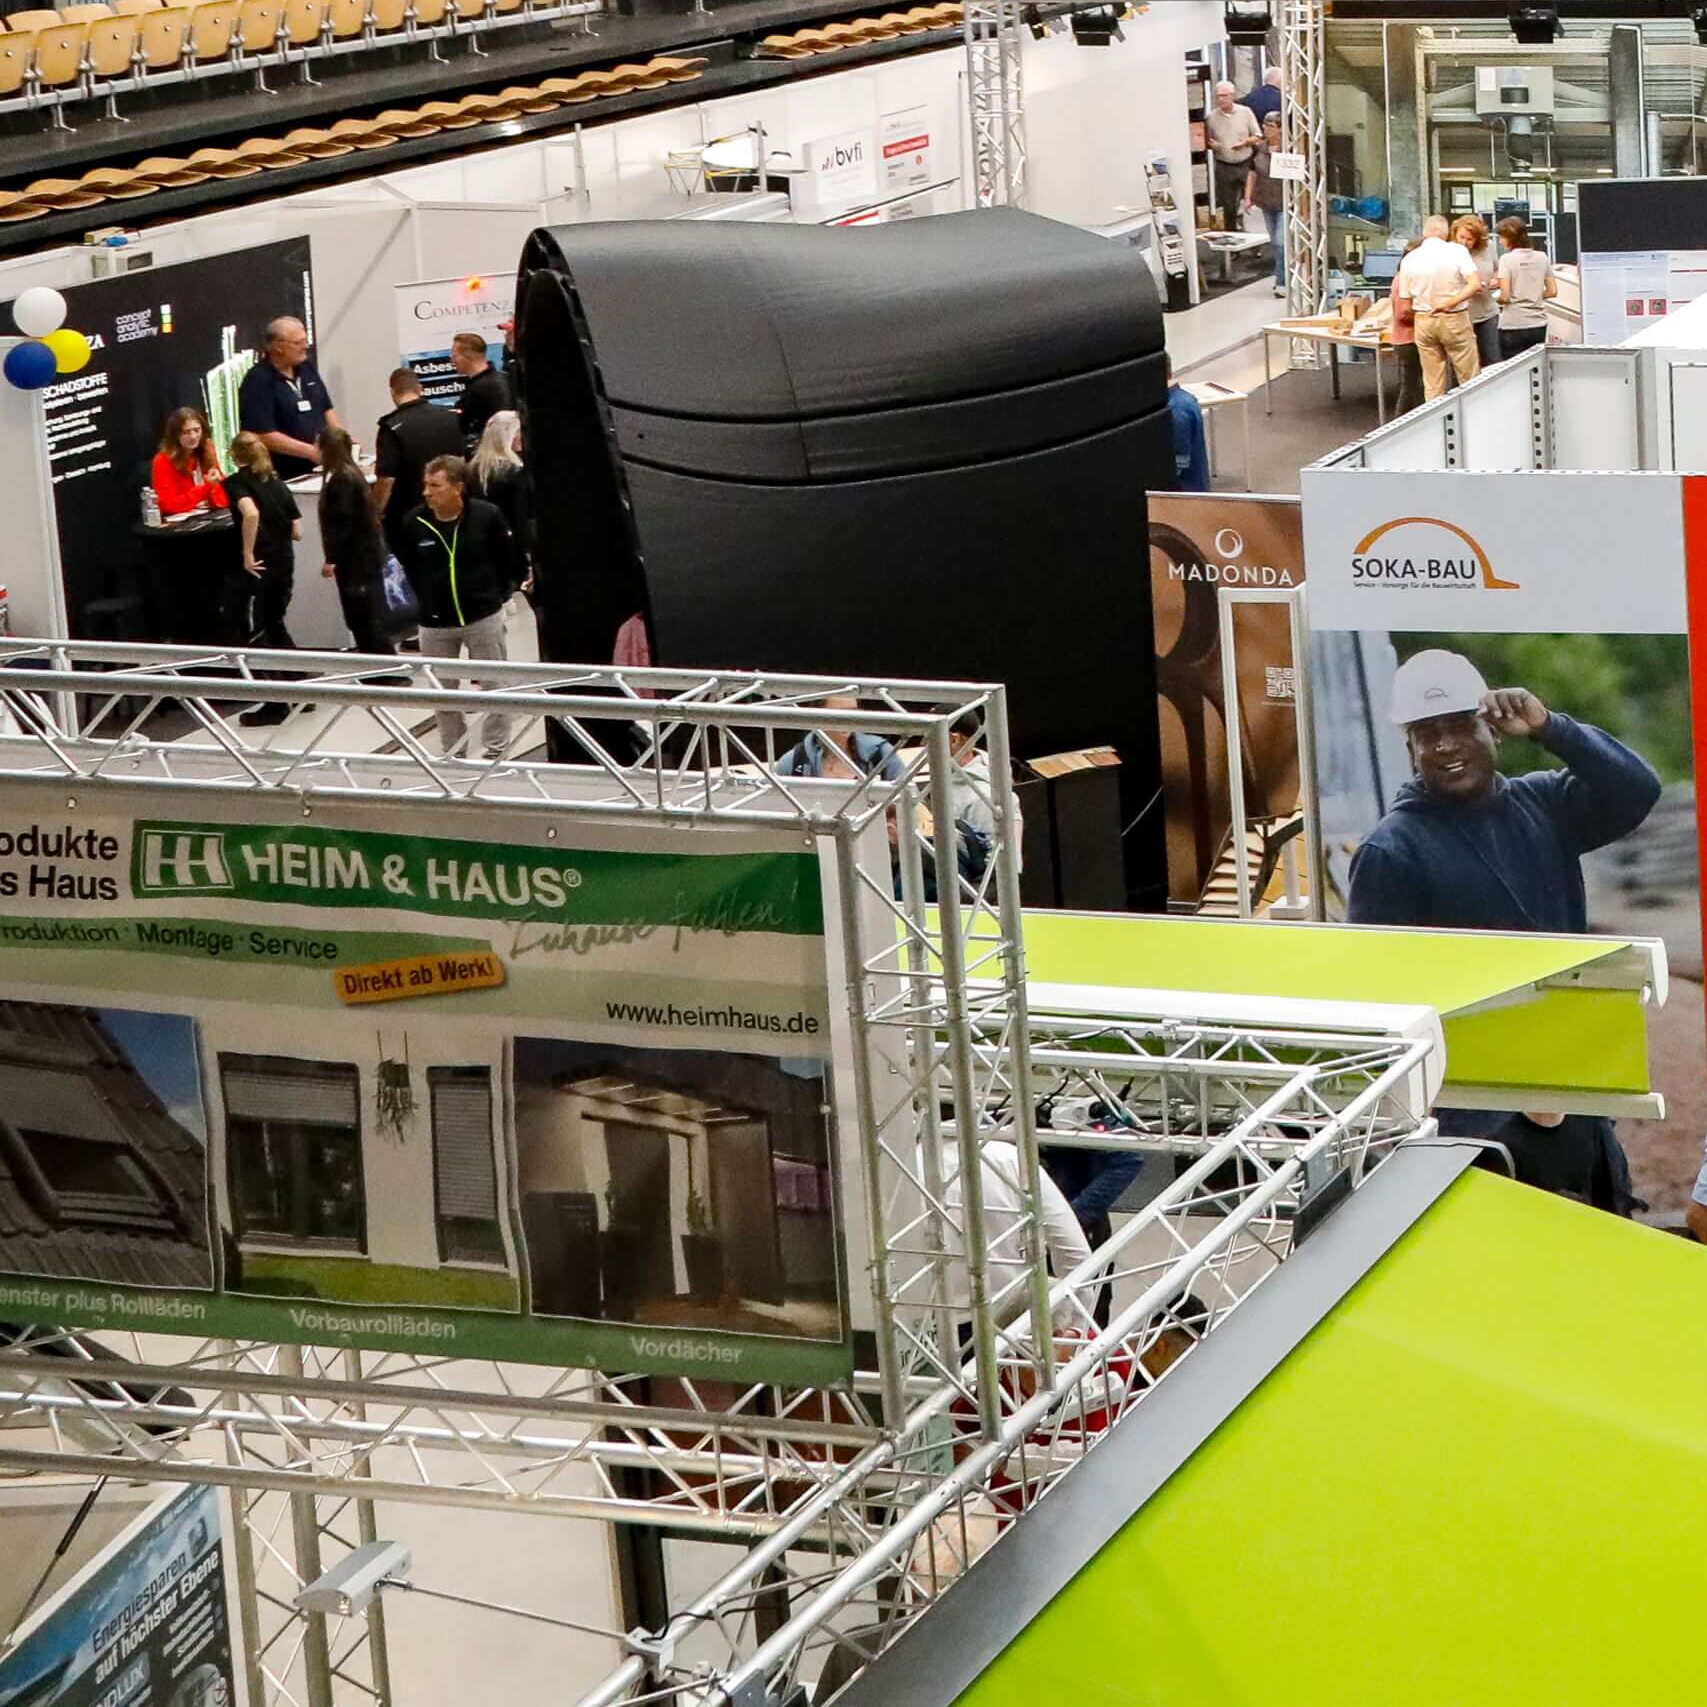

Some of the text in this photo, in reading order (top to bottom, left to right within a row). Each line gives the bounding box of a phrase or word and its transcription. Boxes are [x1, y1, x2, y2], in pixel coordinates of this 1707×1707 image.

[1168, 563, 1295, 587] MADONDA
[1352, 557, 1476, 580] SOKA-BAU
[29, 864, 118, 901] Haus
[240, 843, 369, 890] HEIM
[382, 854, 417, 897] &
[136, 922, 235, 956] Montage
[249, 932, 338, 960] Service
[343, 958, 494, 995] Direkt ab Werk!
[606, 1001, 819, 1034] www.heimhaus.de
[64, 1292, 108, 1314] plus
[111, 1293, 206, 1320] Rollläden
[289, 1308, 457, 1341] Vorbaurollläden
[630, 1335, 743, 1365] Vordächer
[91, 1551, 187, 1653] Energiesparen
[95, 1550, 219, 1685] auf höchster Ebene
